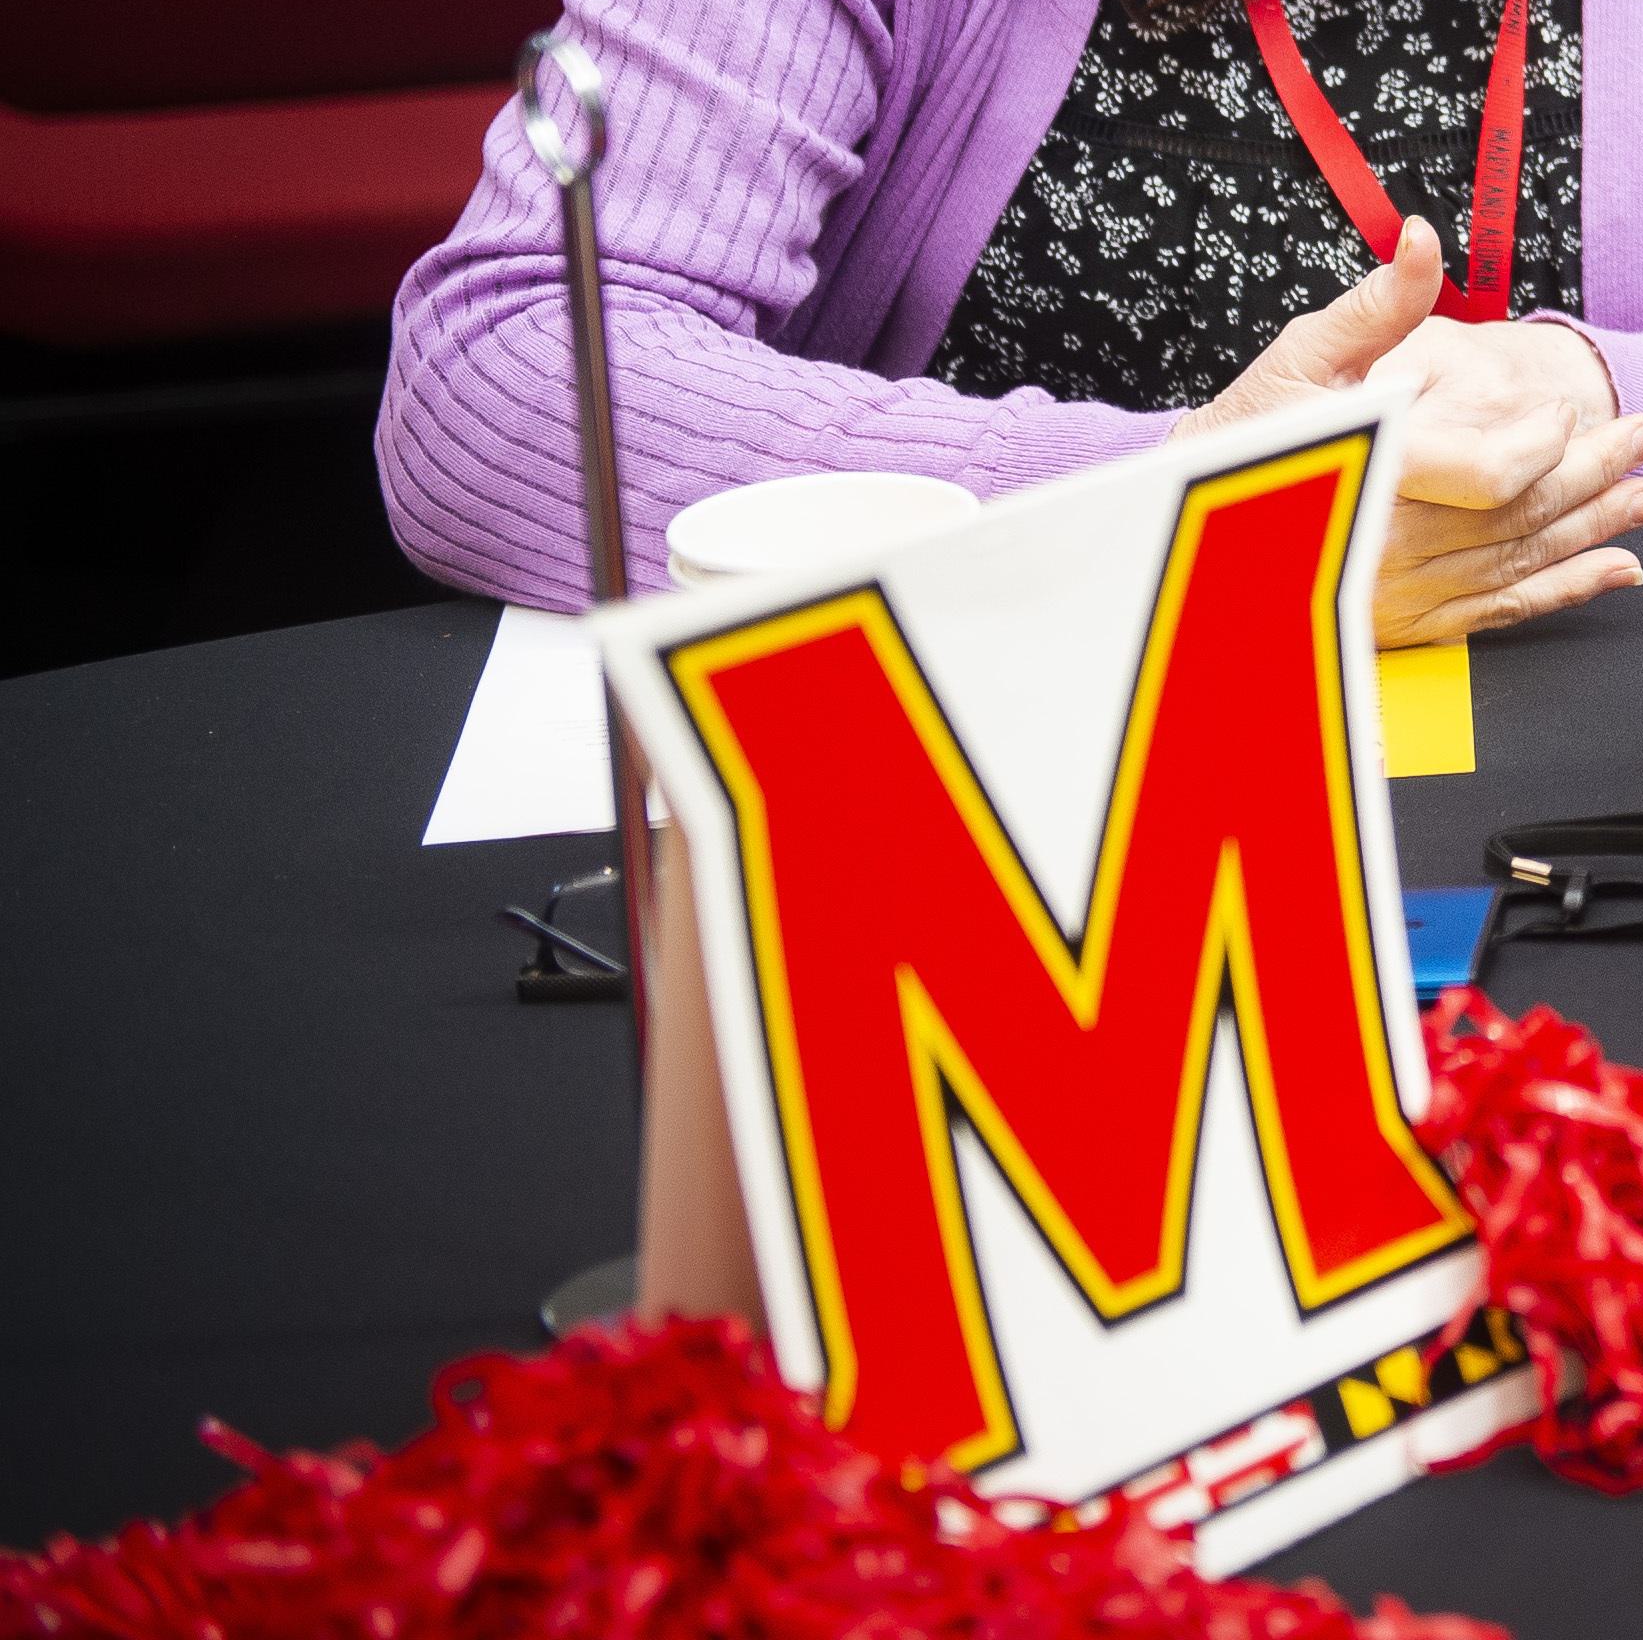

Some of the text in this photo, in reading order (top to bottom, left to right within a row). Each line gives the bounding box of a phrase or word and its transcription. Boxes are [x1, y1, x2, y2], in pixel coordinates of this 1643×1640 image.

[1471, 127, 1513, 293] MARYLAND ALUMNI
[660, 420, 1478, 1480] M
